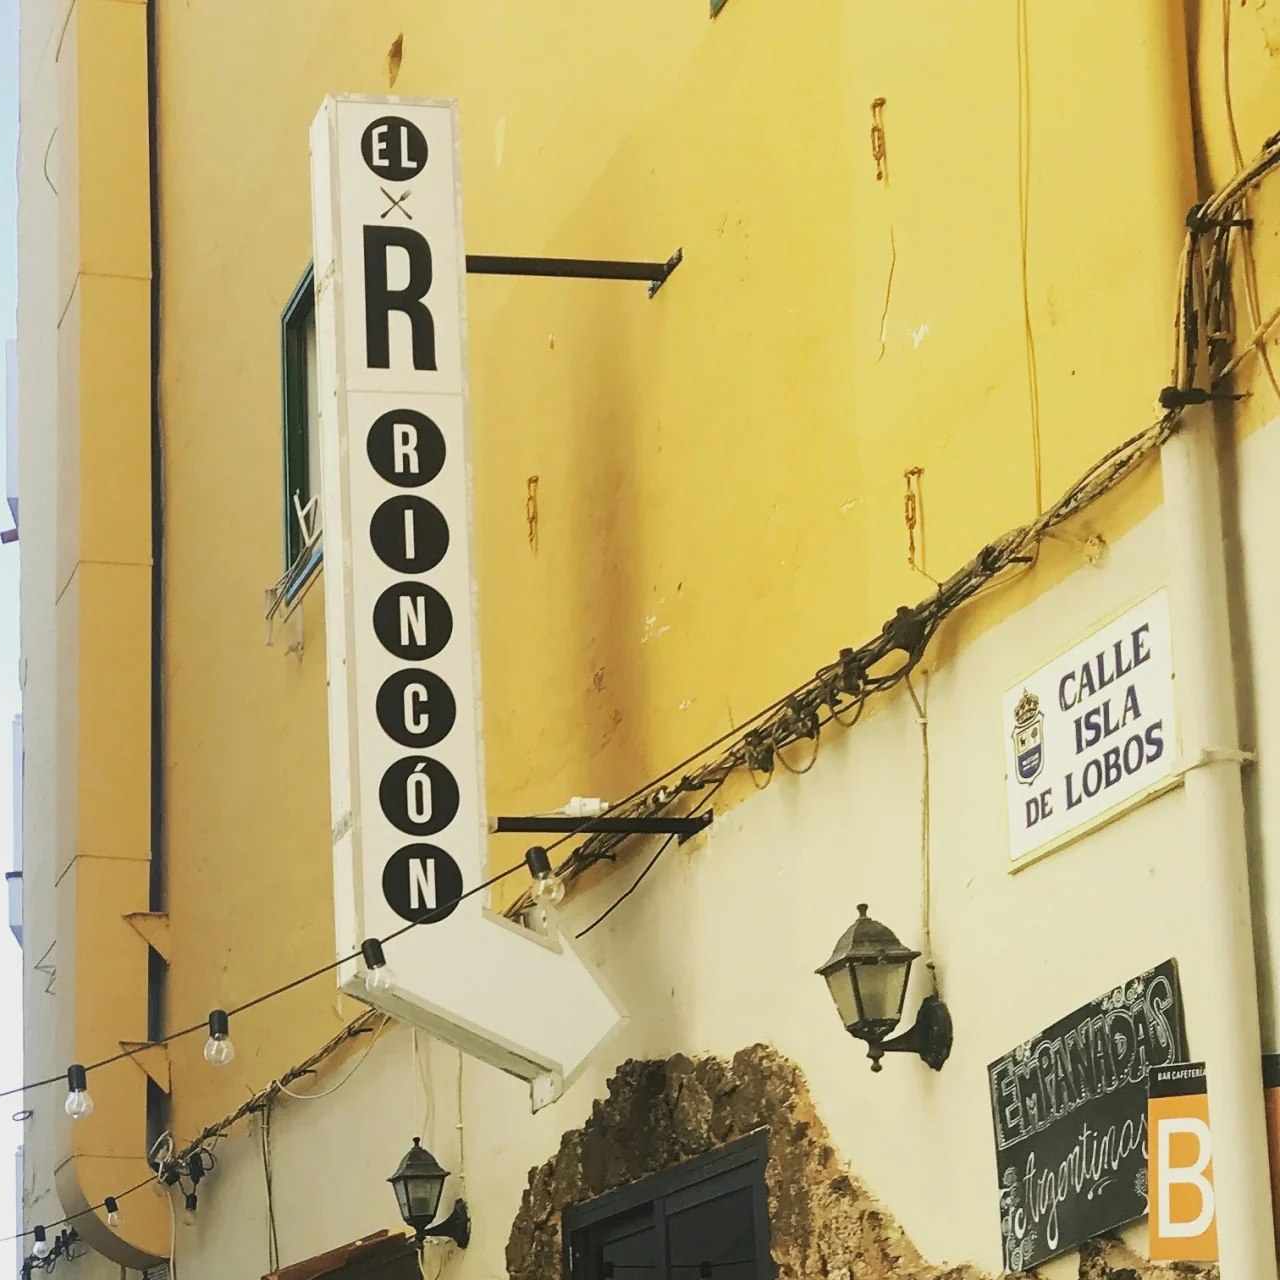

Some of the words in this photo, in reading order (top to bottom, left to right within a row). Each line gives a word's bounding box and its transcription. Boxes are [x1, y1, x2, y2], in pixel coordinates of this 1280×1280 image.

[371, 124, 418, 169] EL
[363, 224, 438, 372] R
[1058, 622, 1151, 712] CALLE
[1073, 683, 1142, 755] ISLA
[1025, 787, 1053, 829] DE
[1064, 719, 1164, 811] LOBOS
[990, 975, 1176, 1150] EMPANADAS
[1157, 1071, 1171, 1081] BAR
[1157, 1117, 1216, 1238] B
